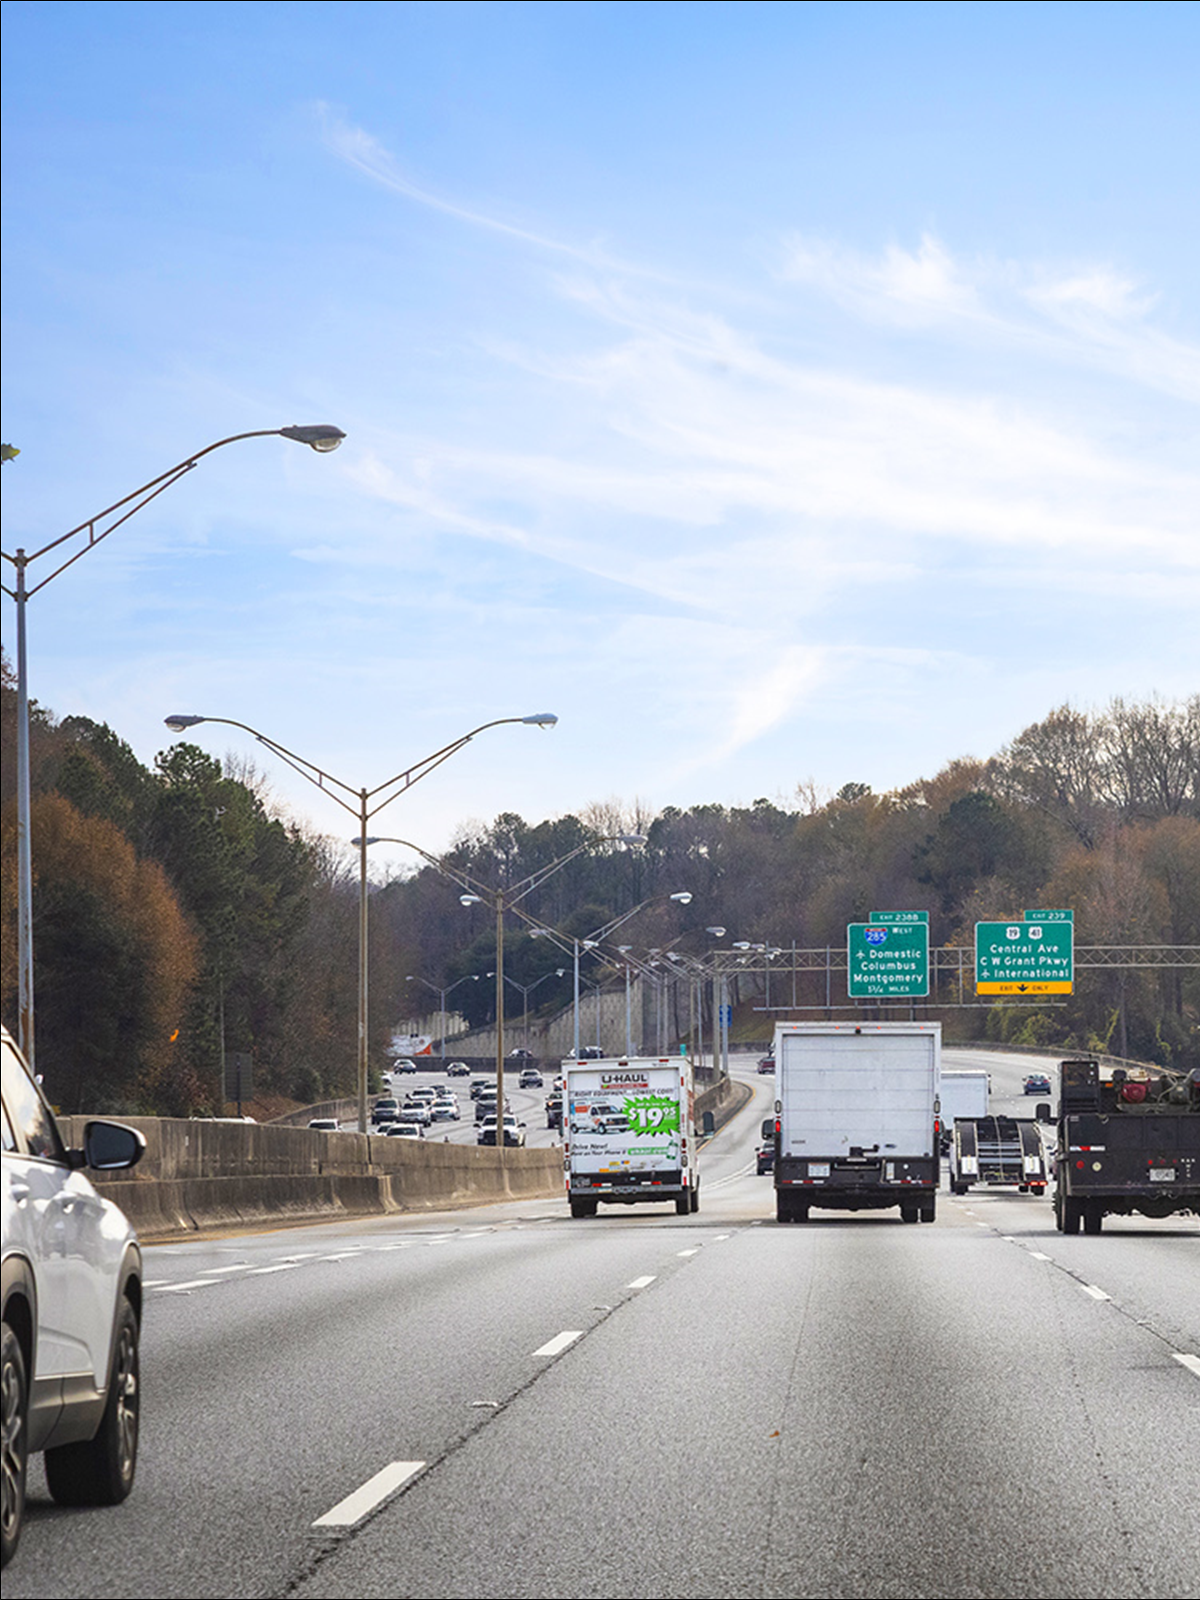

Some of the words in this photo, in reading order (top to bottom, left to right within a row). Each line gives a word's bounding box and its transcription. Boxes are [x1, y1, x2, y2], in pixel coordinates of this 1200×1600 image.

[892, 927, 913, 935] WEST
[1008, 928, 1018, 937] 19
[1030, 928, 1041, 937] 41
[868, 932, 887, 942] 285
[990, 943, 1032, 953] Central
[1037, 944, 1059, 953] Ave
[869, 949, 922, 959] Domestic
[860, 961, 917, 970] Columbus
[979, 956, 988, 966] C
[991, 957, 1001, 965] W
[1004, 956, 1035, 966] Grant
[1039, 956, 1069, 967] Pkwy
[994, 968, 1069, 978] International
[853, 973, 923, 984] Montgomery
[601, 1074, 648, 1084] U-HAUL
